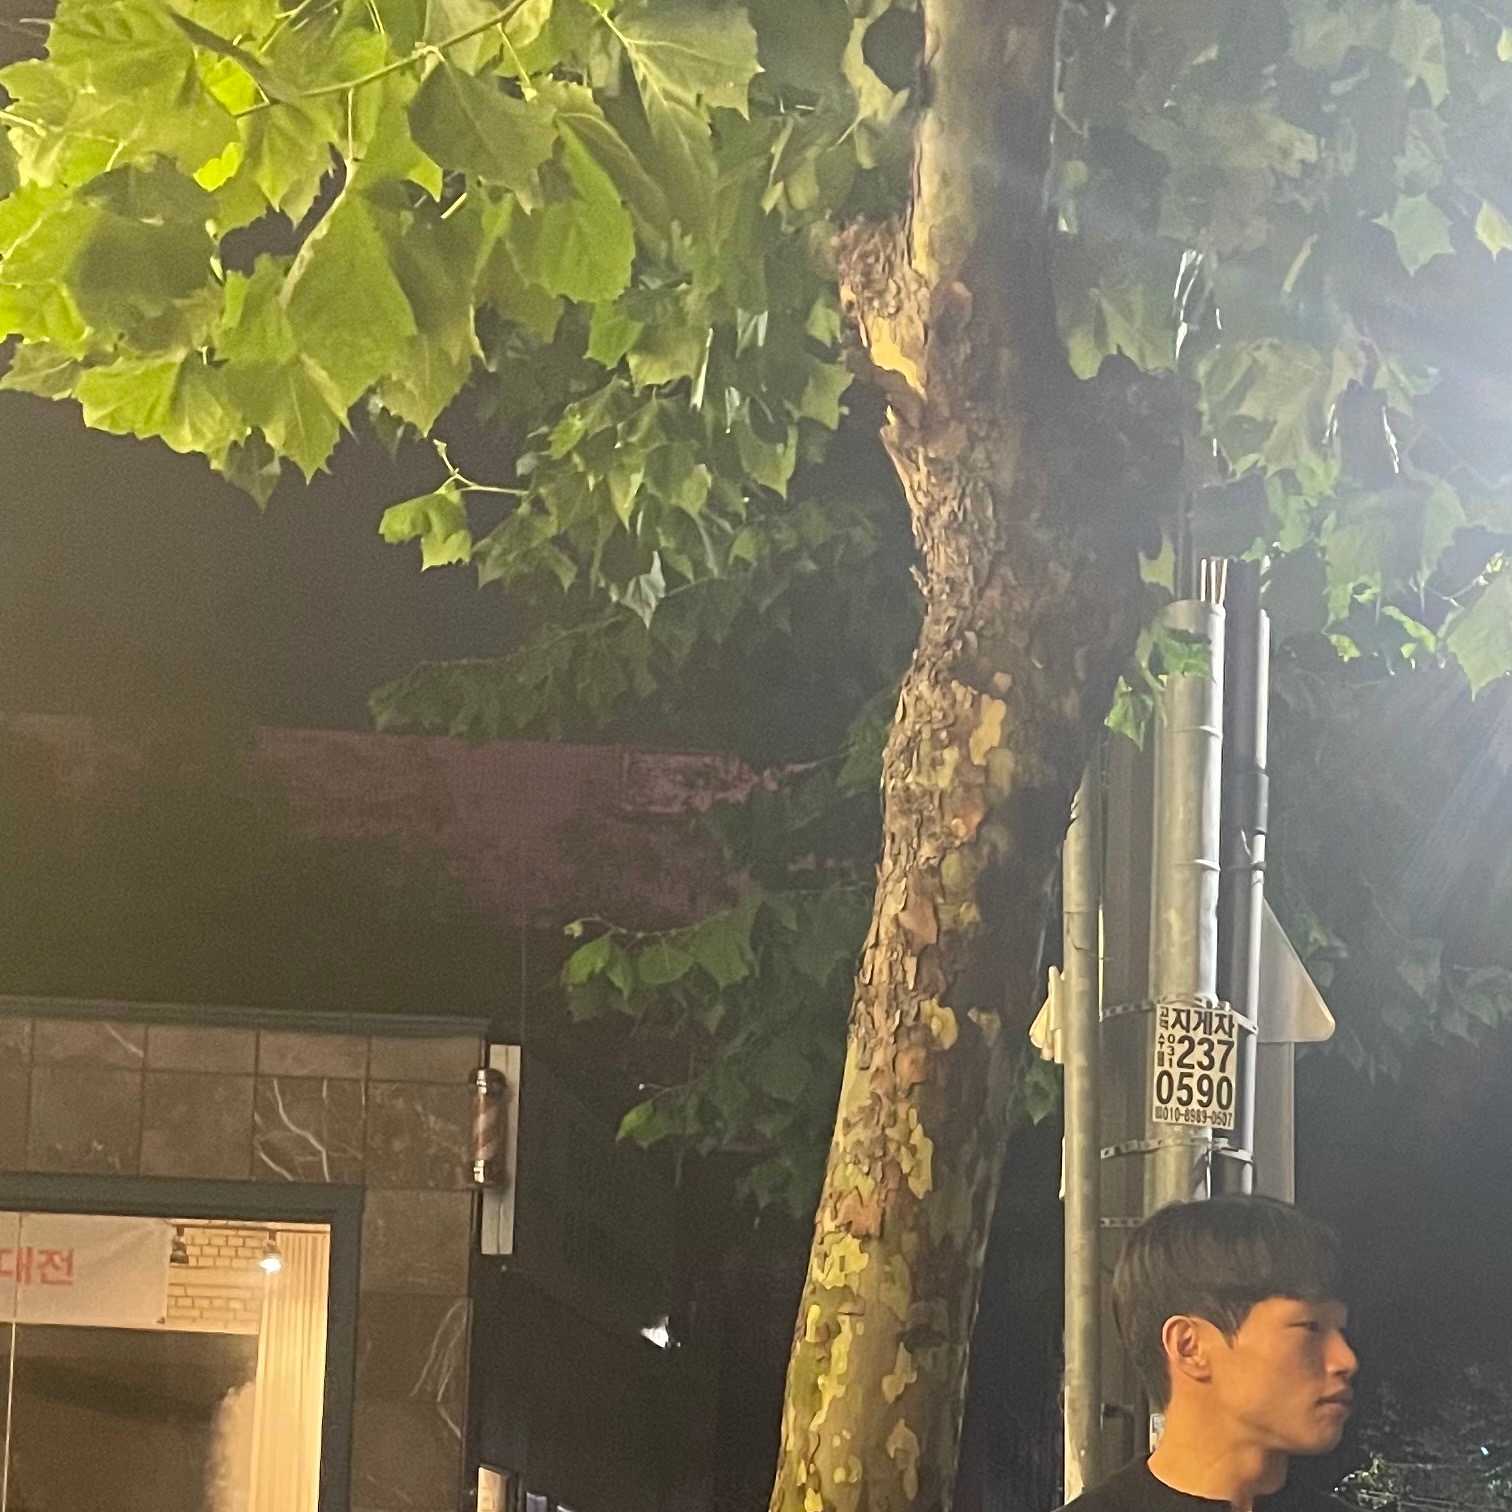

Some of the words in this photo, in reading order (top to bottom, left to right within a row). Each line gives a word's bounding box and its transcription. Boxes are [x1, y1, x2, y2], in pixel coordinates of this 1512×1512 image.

[1166, 1033, 1176, 1069] 031
[1176, 1034, 1235, 1073] 237
[1156, 1069, 1233, 1111] 0590
